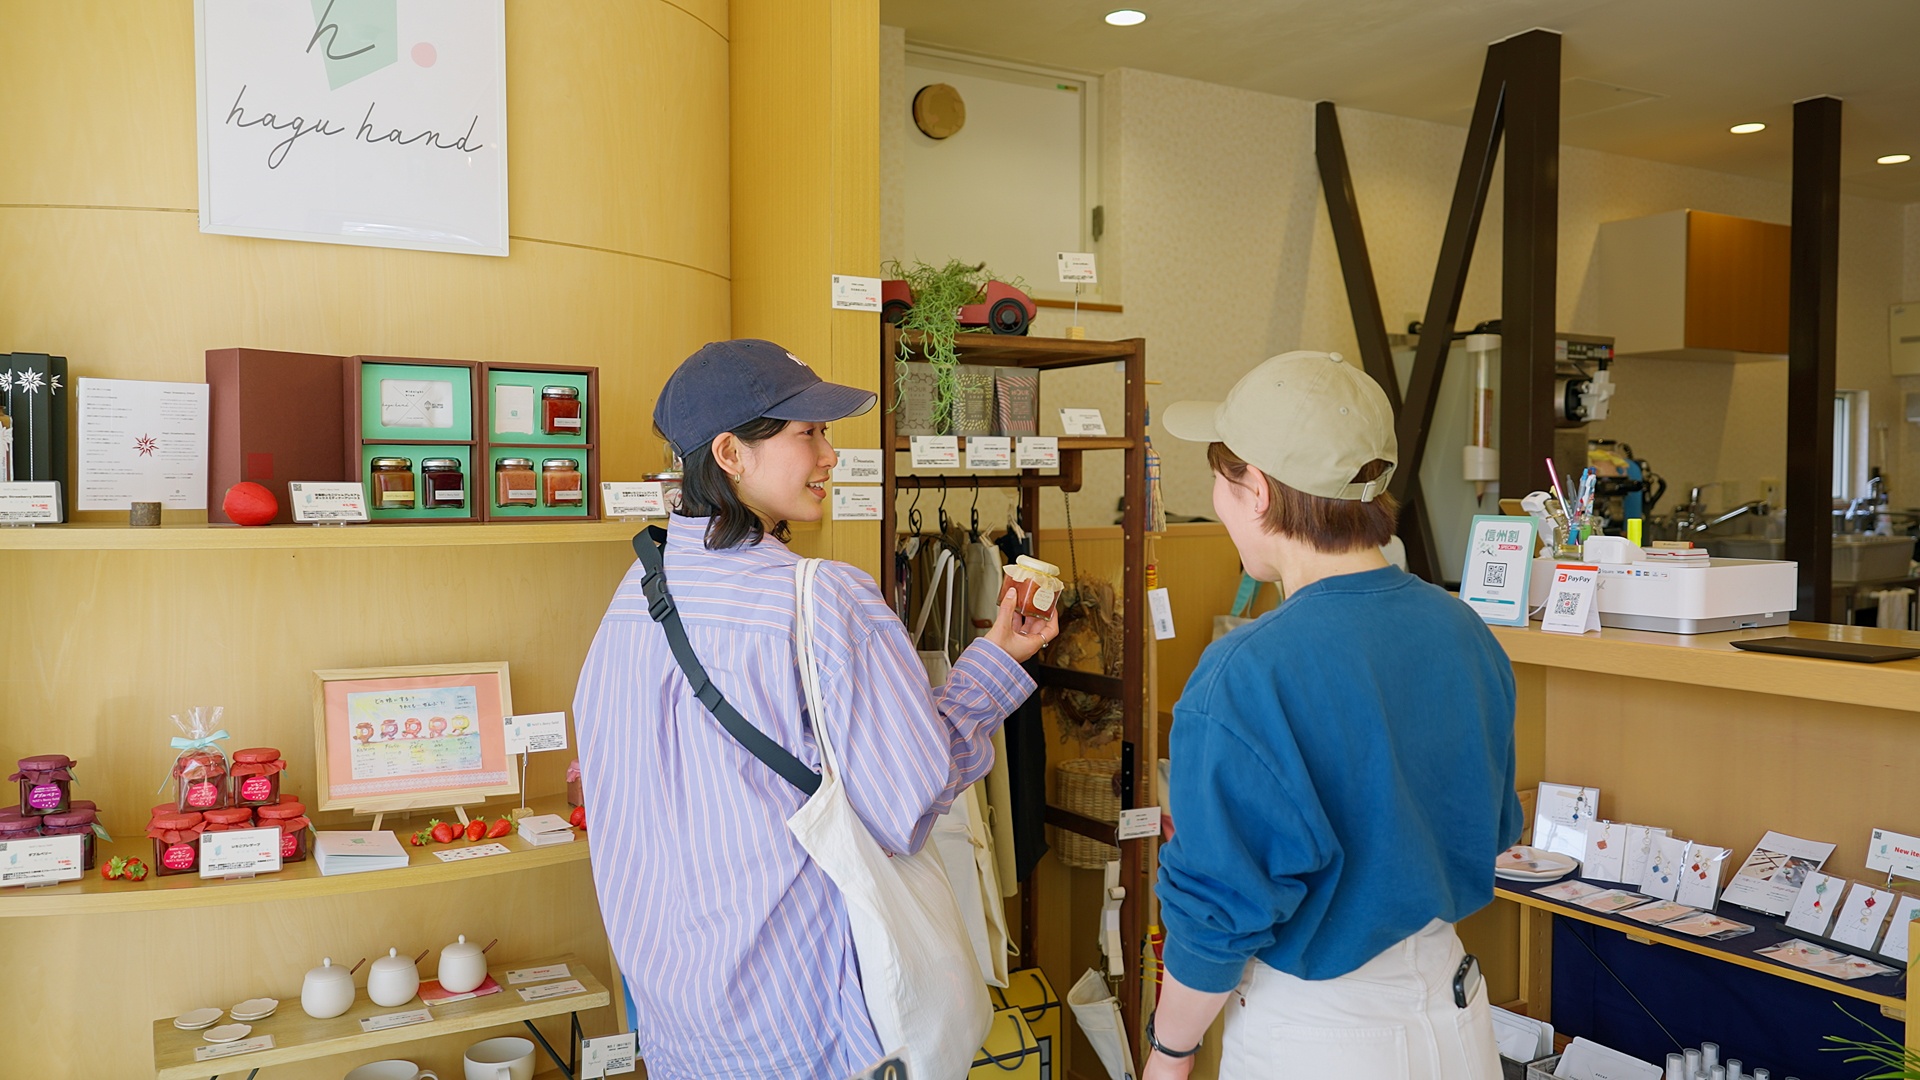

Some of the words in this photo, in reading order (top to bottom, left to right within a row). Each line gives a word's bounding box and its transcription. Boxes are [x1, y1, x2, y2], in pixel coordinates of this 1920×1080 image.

[226, 85, 345, 170] hagu
[356, 102, 484, 153] hand
[1485, 529, 1520, 543] 信州割
[1567, 575, 1590, 583] PayPay
[1894, 846, 1909, 855] New
[1910, 849, 1920, 858] ite
